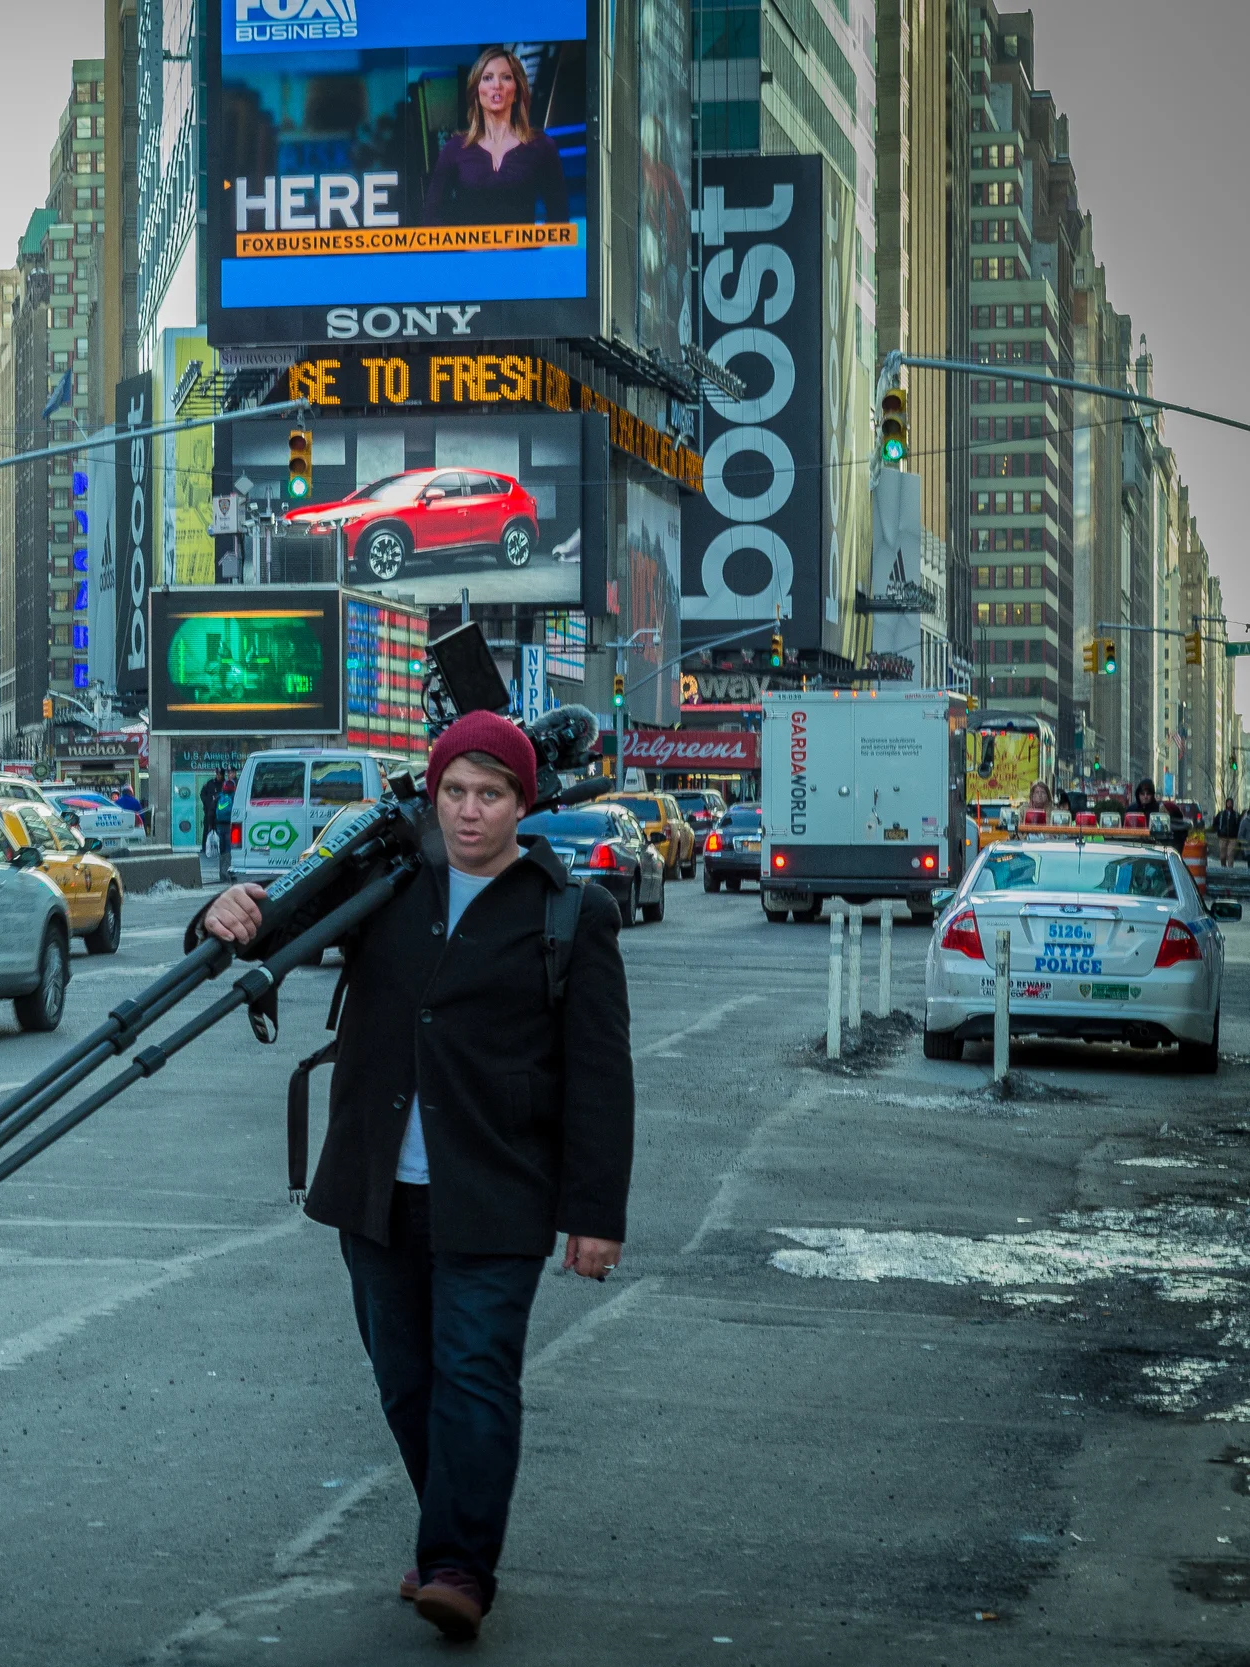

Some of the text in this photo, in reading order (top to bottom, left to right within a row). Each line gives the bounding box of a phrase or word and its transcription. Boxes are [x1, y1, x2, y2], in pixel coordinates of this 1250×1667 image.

[236, 22, 357, 42] BUSINESS
[235, 171, 400, 231] HERE
[242, 228, 571, 253] FOXBUSINESS.COM/CHANNELFINDER
[326, 305, 481, 339] SONY
[222, 352, 292, 366] SHERWOOD
[362, 357, 410, 403] TO
[680, 183, 796, 620] boost
[128, 392, 146, 671] boost
[528, 649, 539, 722] NYPD
[68, 742, 126, 757] nuchas
[623, 732, 746, 765] Walgreens
[791, 711, 806, 836] GARDAWORLD
[251, 825, 290, 845] GO
[325, 808, 381, 854] MILLER
[1049, 925, 1083, 939] 5126
[1043, 943, 1094, 958] NYPD
[1035, 957, 1102, 974] POLICE
[1017, 980, 1051, 989] REWARD
